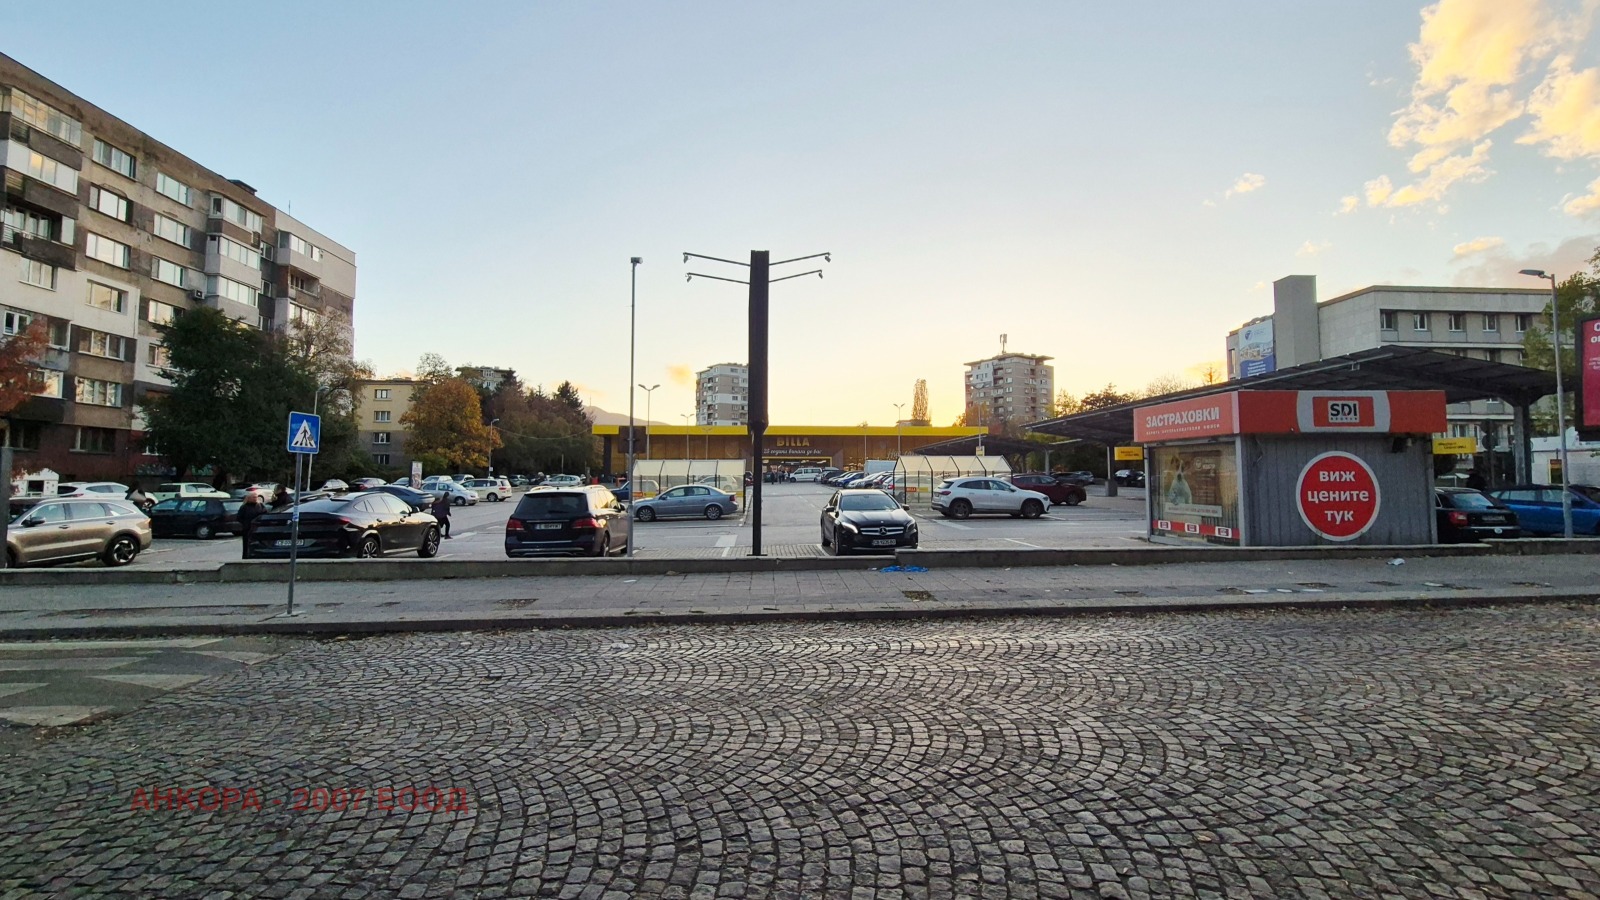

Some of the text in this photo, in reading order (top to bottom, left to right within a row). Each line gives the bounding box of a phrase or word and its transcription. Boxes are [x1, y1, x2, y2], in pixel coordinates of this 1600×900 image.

[1330, 403, 1358, 417] SDI
[1146, 407, 1220, 428] ЗАСТРАХОВКИ
[777, 436, 810, 447] BILLA
[1319, 470, 1356, 482] виж
[1307, 490, 1369, 504] цените
[1324, 510, 1354, 525] тук
